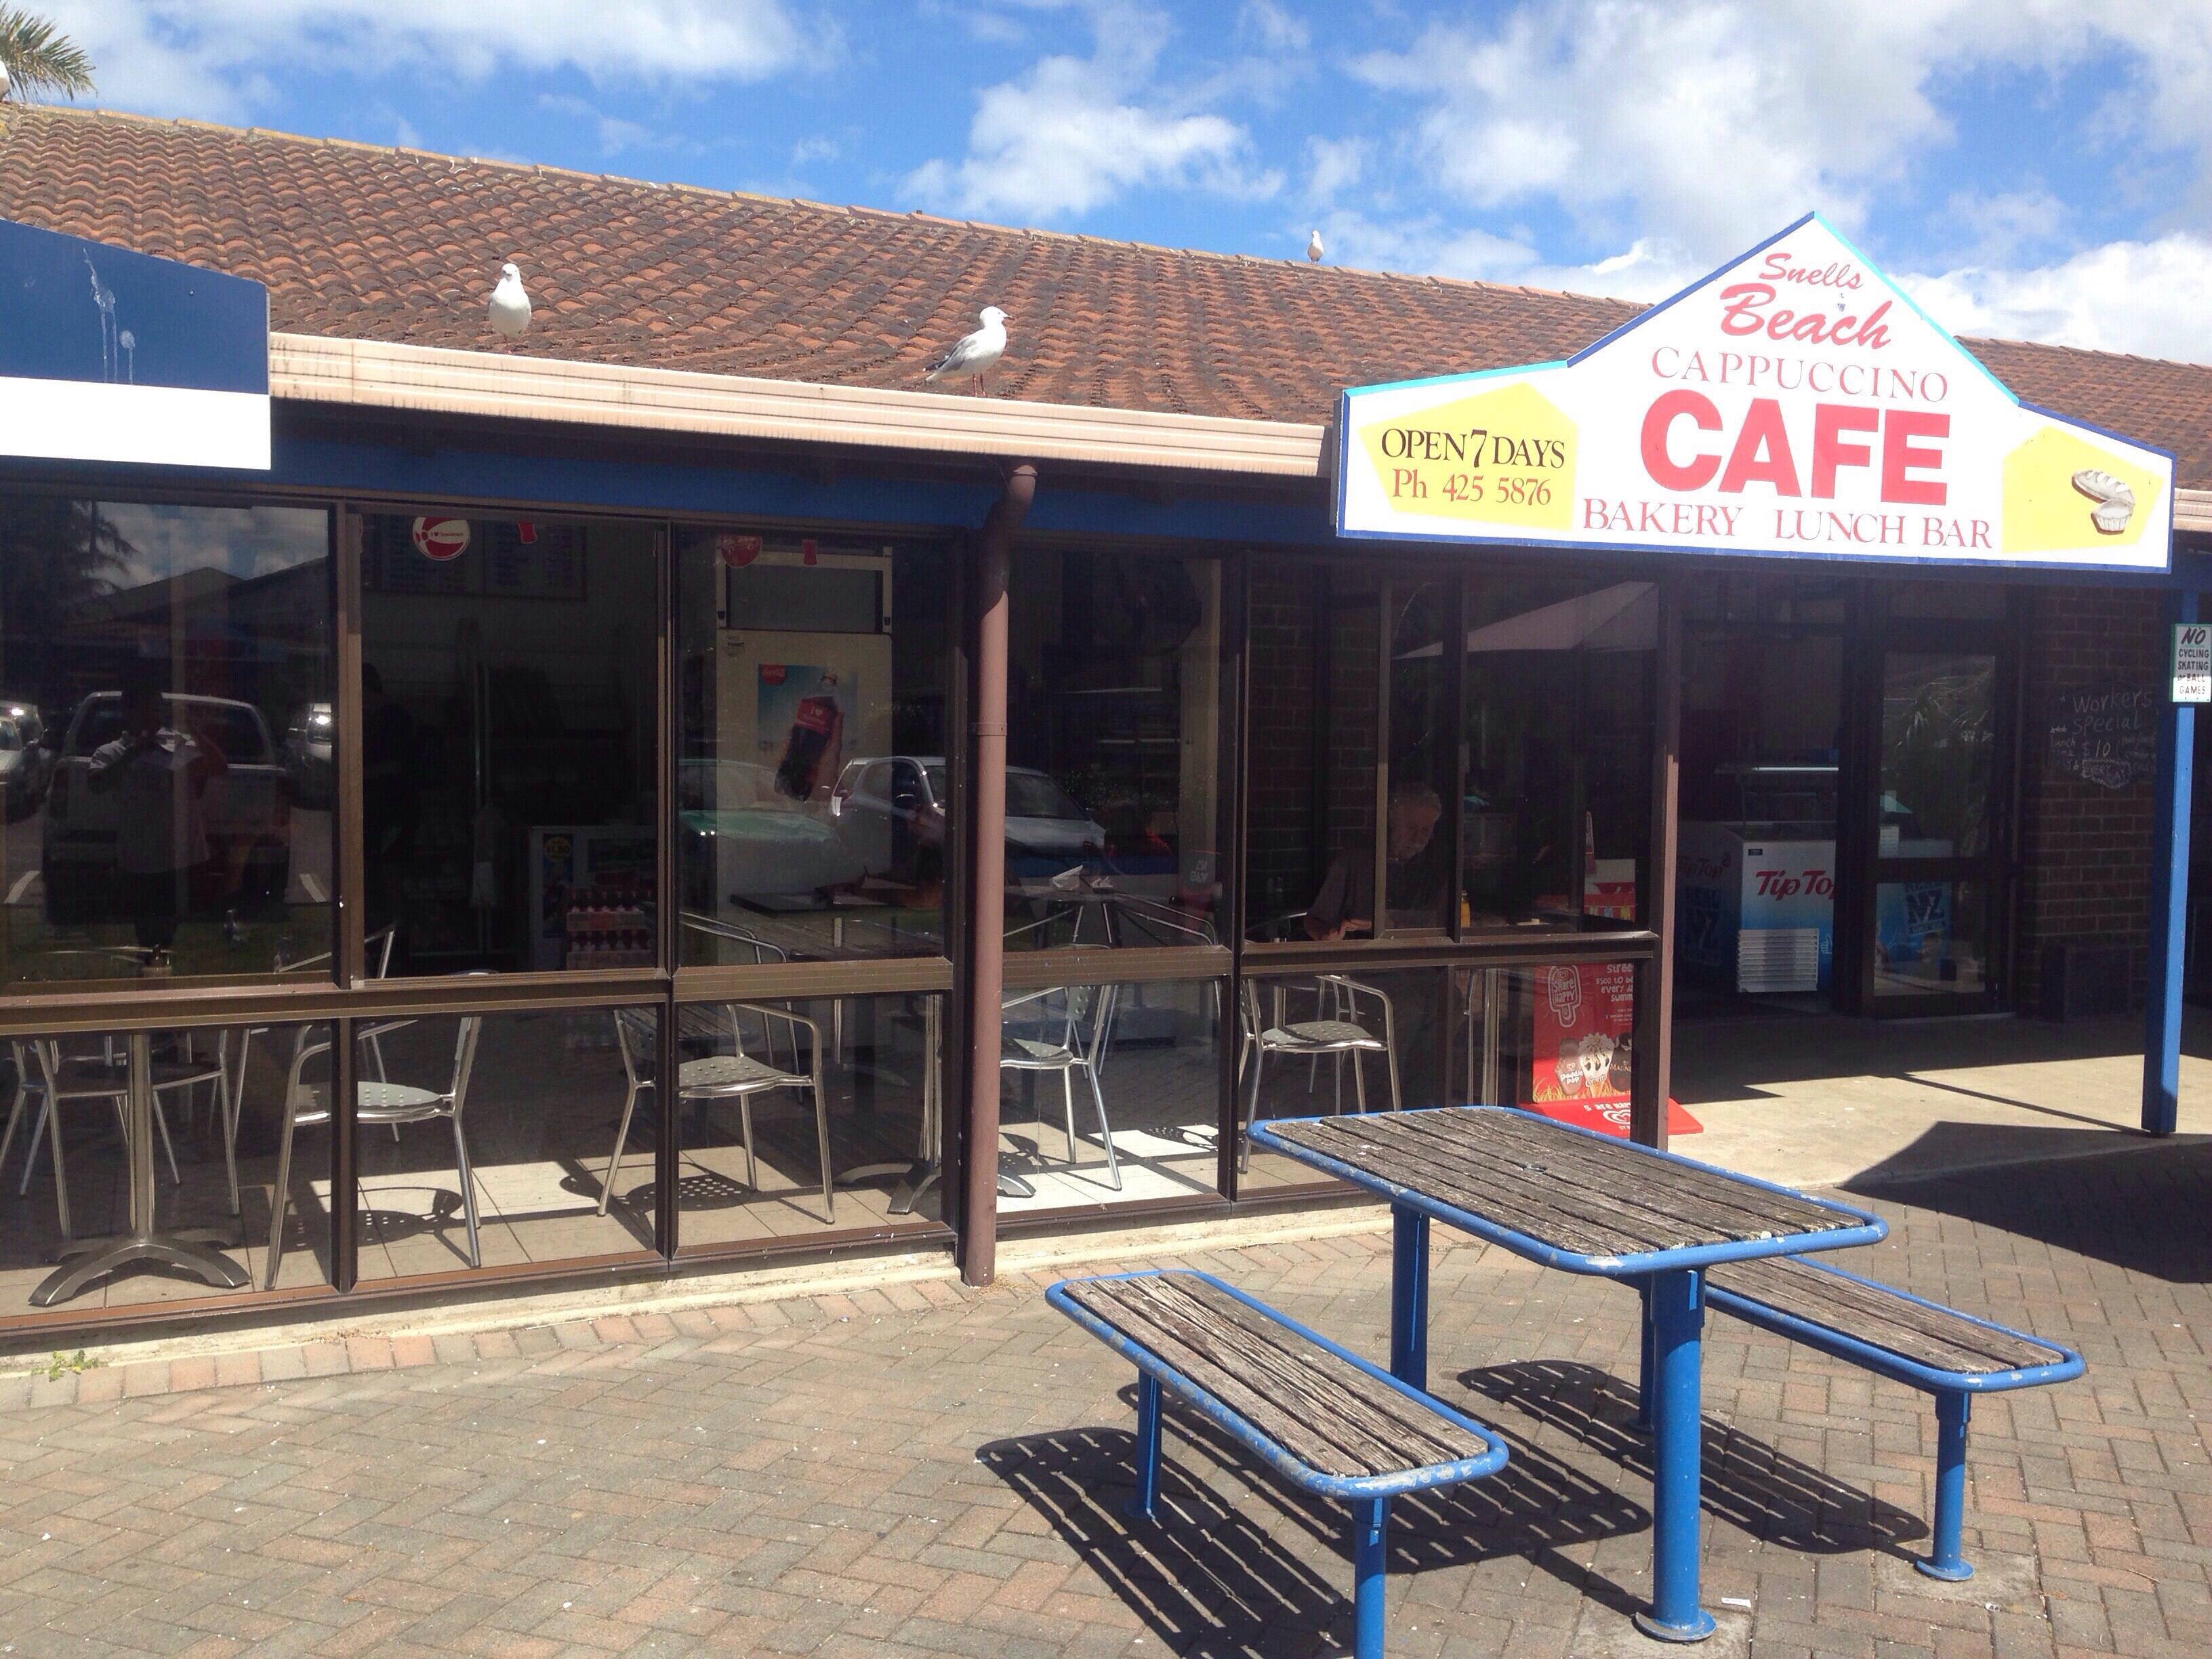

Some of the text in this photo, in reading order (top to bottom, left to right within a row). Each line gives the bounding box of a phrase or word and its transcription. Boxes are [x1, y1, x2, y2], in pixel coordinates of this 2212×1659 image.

[1757, 252, 1864, 290] Snells
[1719, 282, 1893, 350] Beach
[1651, 346, 1948, 403] CAPPUCCINO
[1381, 428, 1565, 469] OPEN 7 DAYS
[1640, 388, 1951, 506] CAFE
[1392, 468, 1552, 506] Ph 425 5876
[1582, 497, 1993, 549] BAKERY LUNCH BAR
[2181, 627, 2207, 645] NO
[2177, 661, 2209, 671] SKATING
[2178, 649, 2210, 659] CYCLING
[2179, 685, 2207, 695] GAMES
[2187, 673, 2206, 682] BALL
[2072, 687, 2153, 713] Workers
[1756, 869, 1801, 901] Tip
